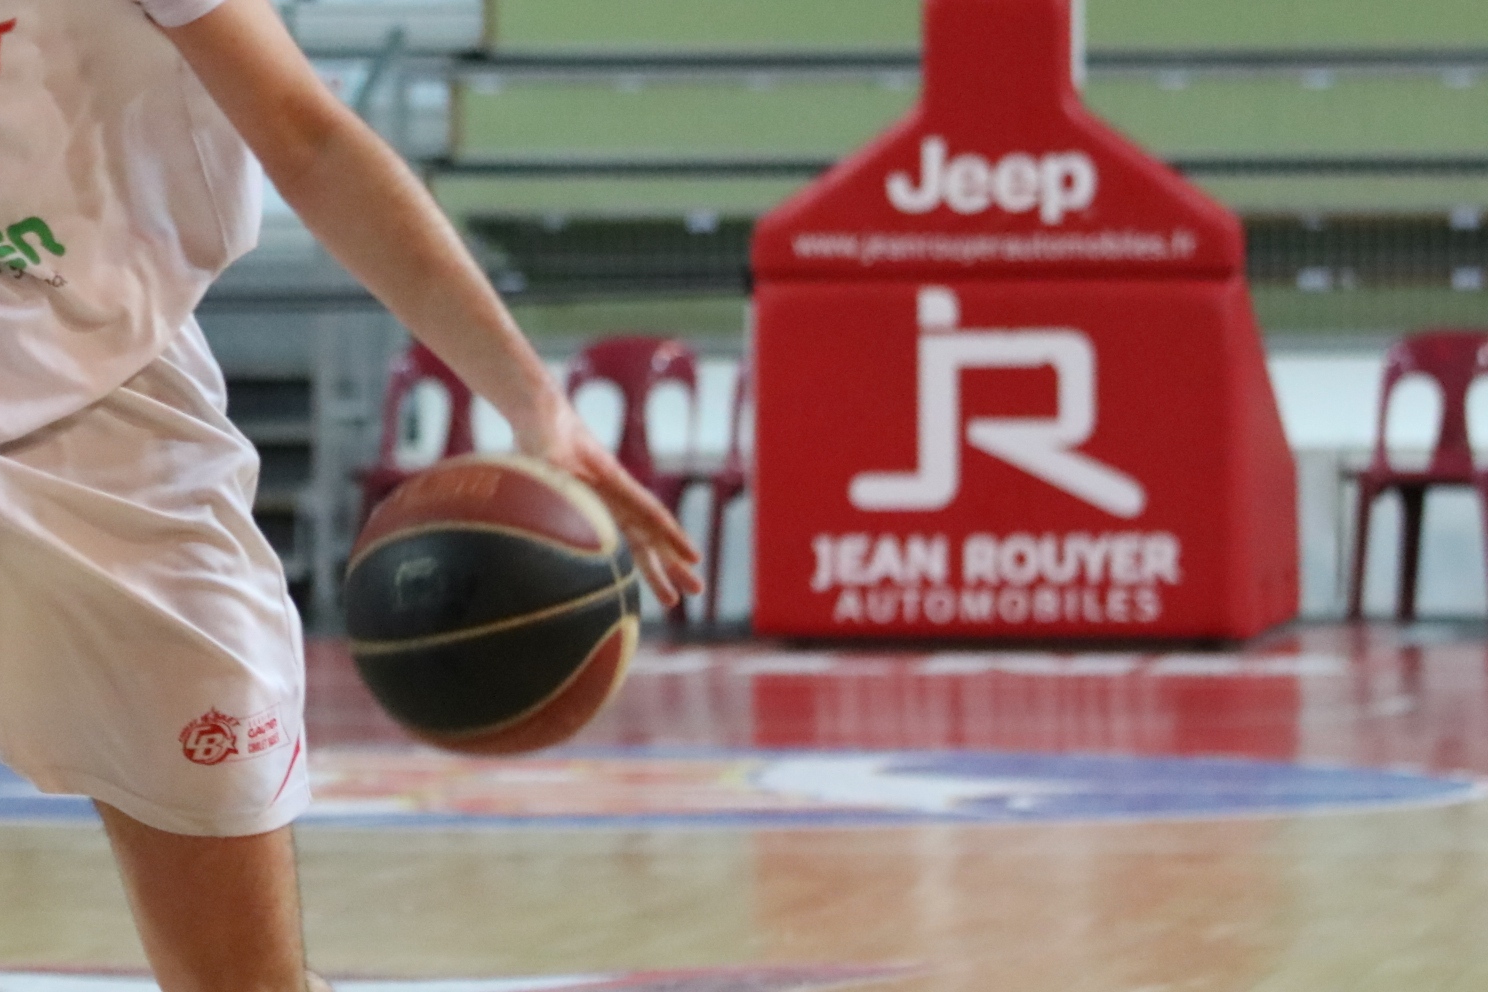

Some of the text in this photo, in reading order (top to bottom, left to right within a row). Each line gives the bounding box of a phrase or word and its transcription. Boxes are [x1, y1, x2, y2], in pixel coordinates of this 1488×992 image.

[885, 135, 1098, 225] Jeep
[811, 533, 1182, 591] JEAN ROUYER
[832, 586, 1163, 624] AUTOMOBILES
